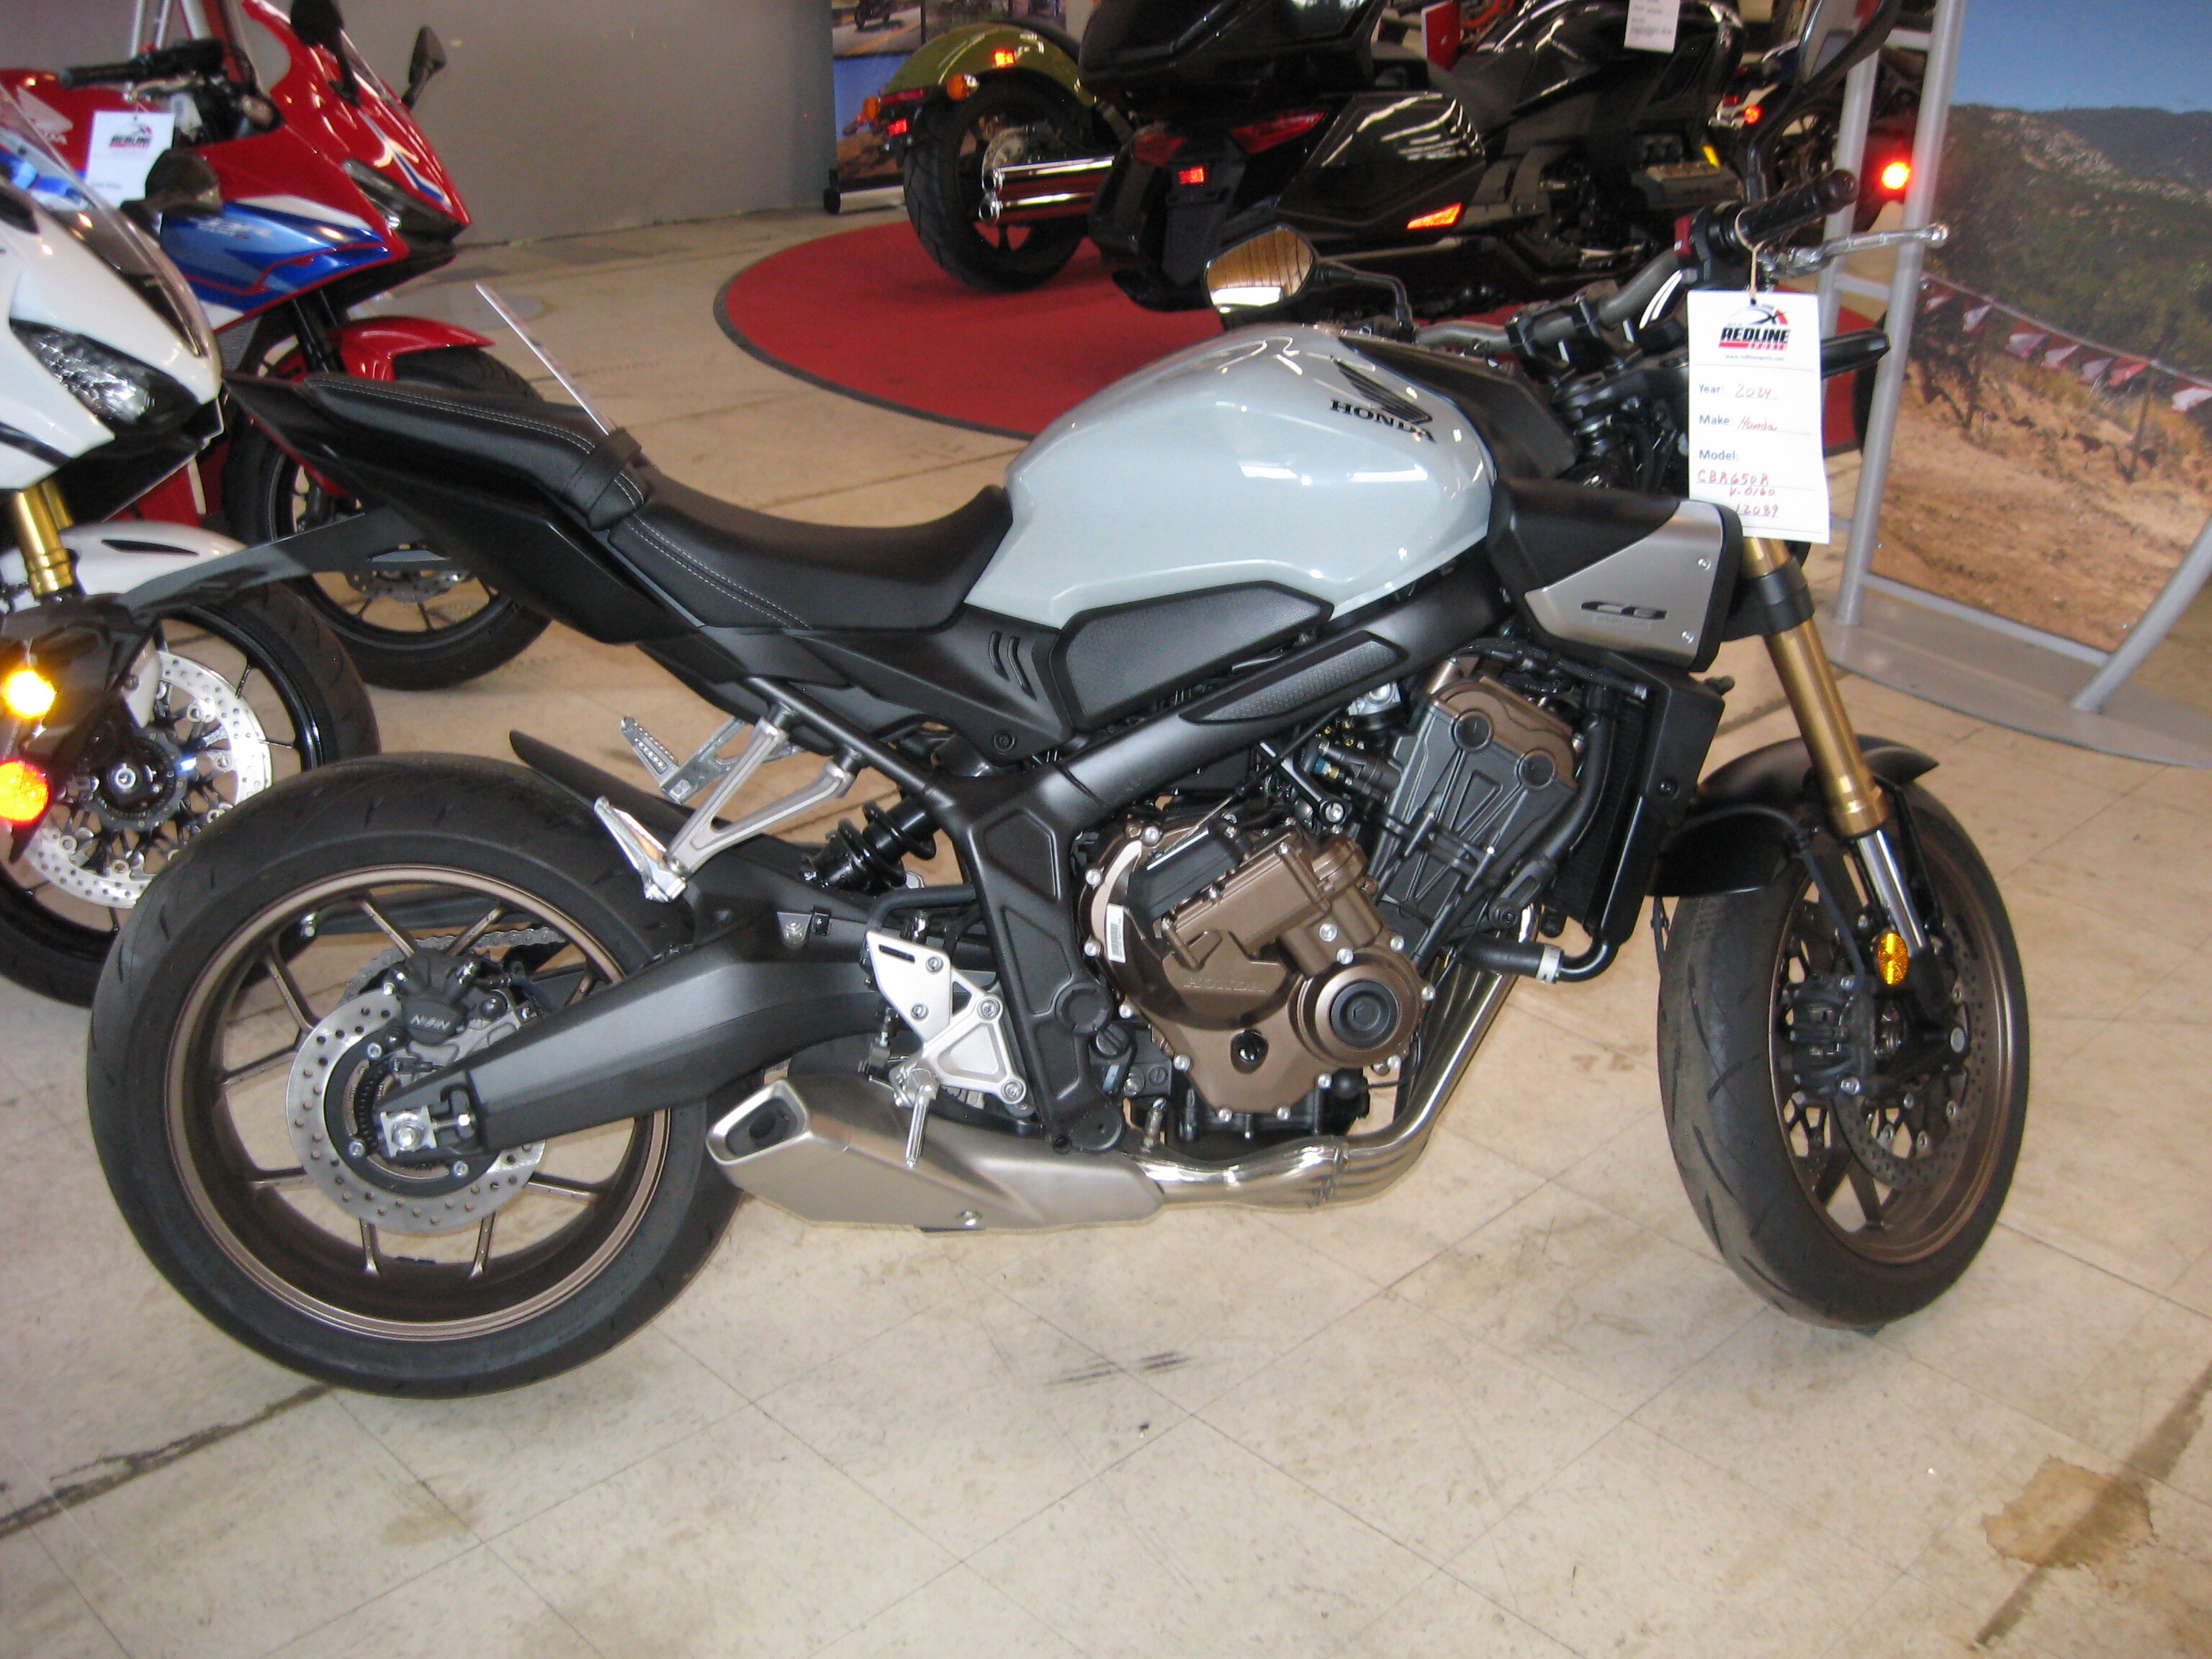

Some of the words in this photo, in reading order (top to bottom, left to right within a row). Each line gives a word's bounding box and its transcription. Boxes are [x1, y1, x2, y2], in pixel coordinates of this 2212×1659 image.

[1721, 327, 1791, 343] REDLINE
[1699, 383, 1724, 394] Year:
[1735, 382, 1772, 399] 2024
[1330, 398, 1437, 444] HONDA
[1699, 414, 1733, 426] Make:
[1737, 415, 1778, 431] Honda
[1699, 449, 1739, 461] Model:
